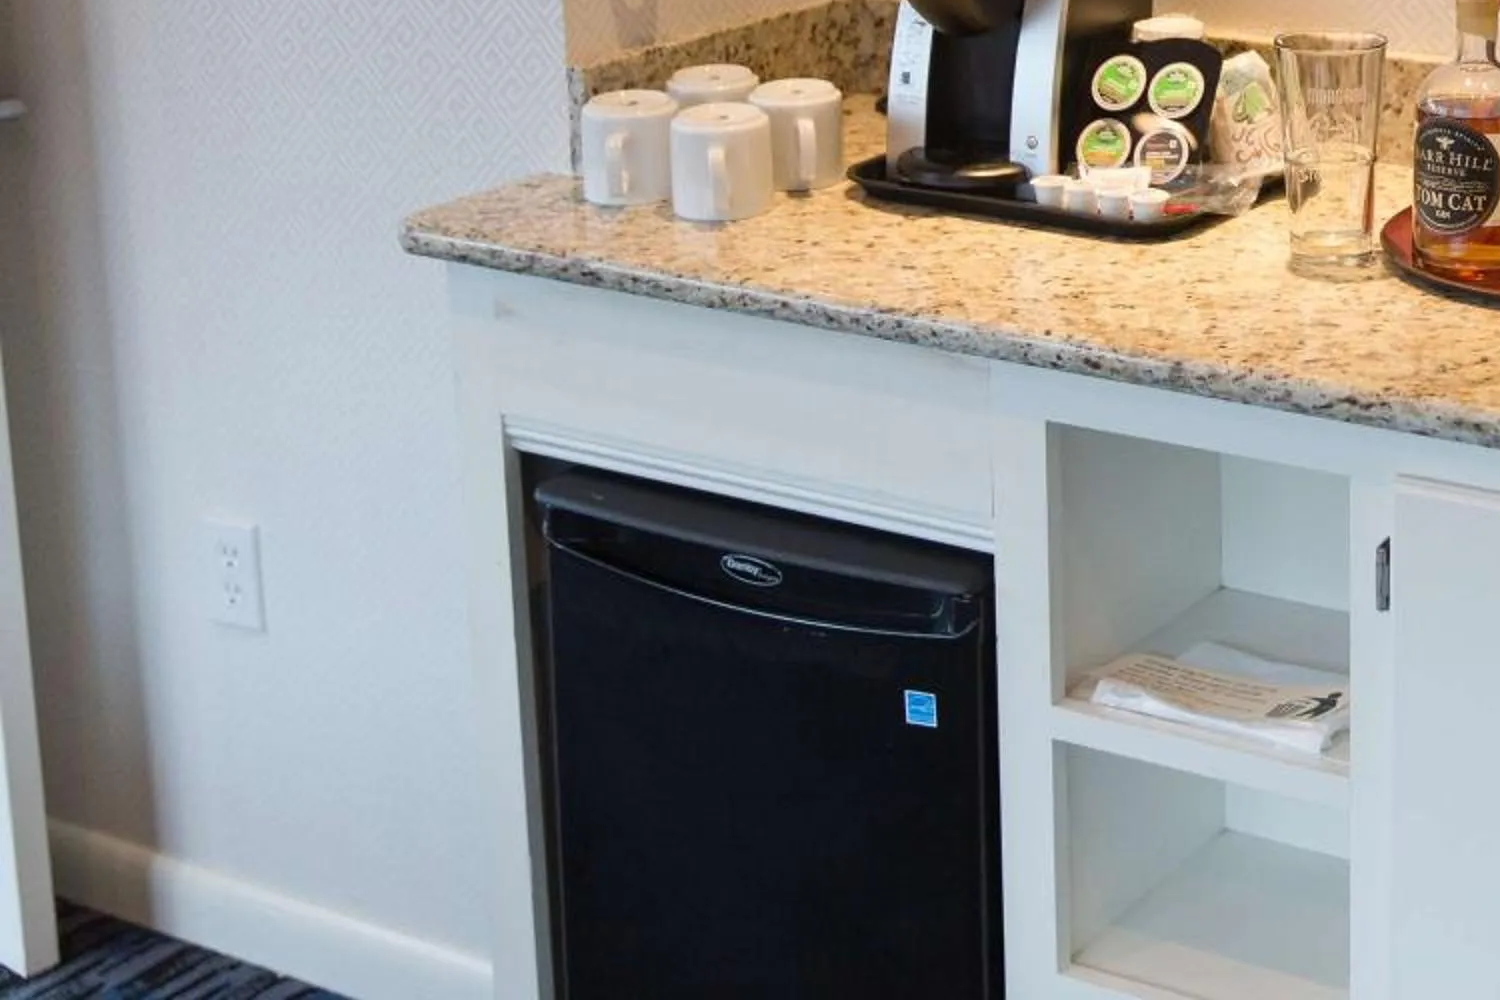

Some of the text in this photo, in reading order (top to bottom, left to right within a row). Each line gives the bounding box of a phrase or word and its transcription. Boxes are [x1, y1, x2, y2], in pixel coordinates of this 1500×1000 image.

[1419, 148, 1493, 171] ARR HILL
[1448, 193, 1487, 212] CAT
